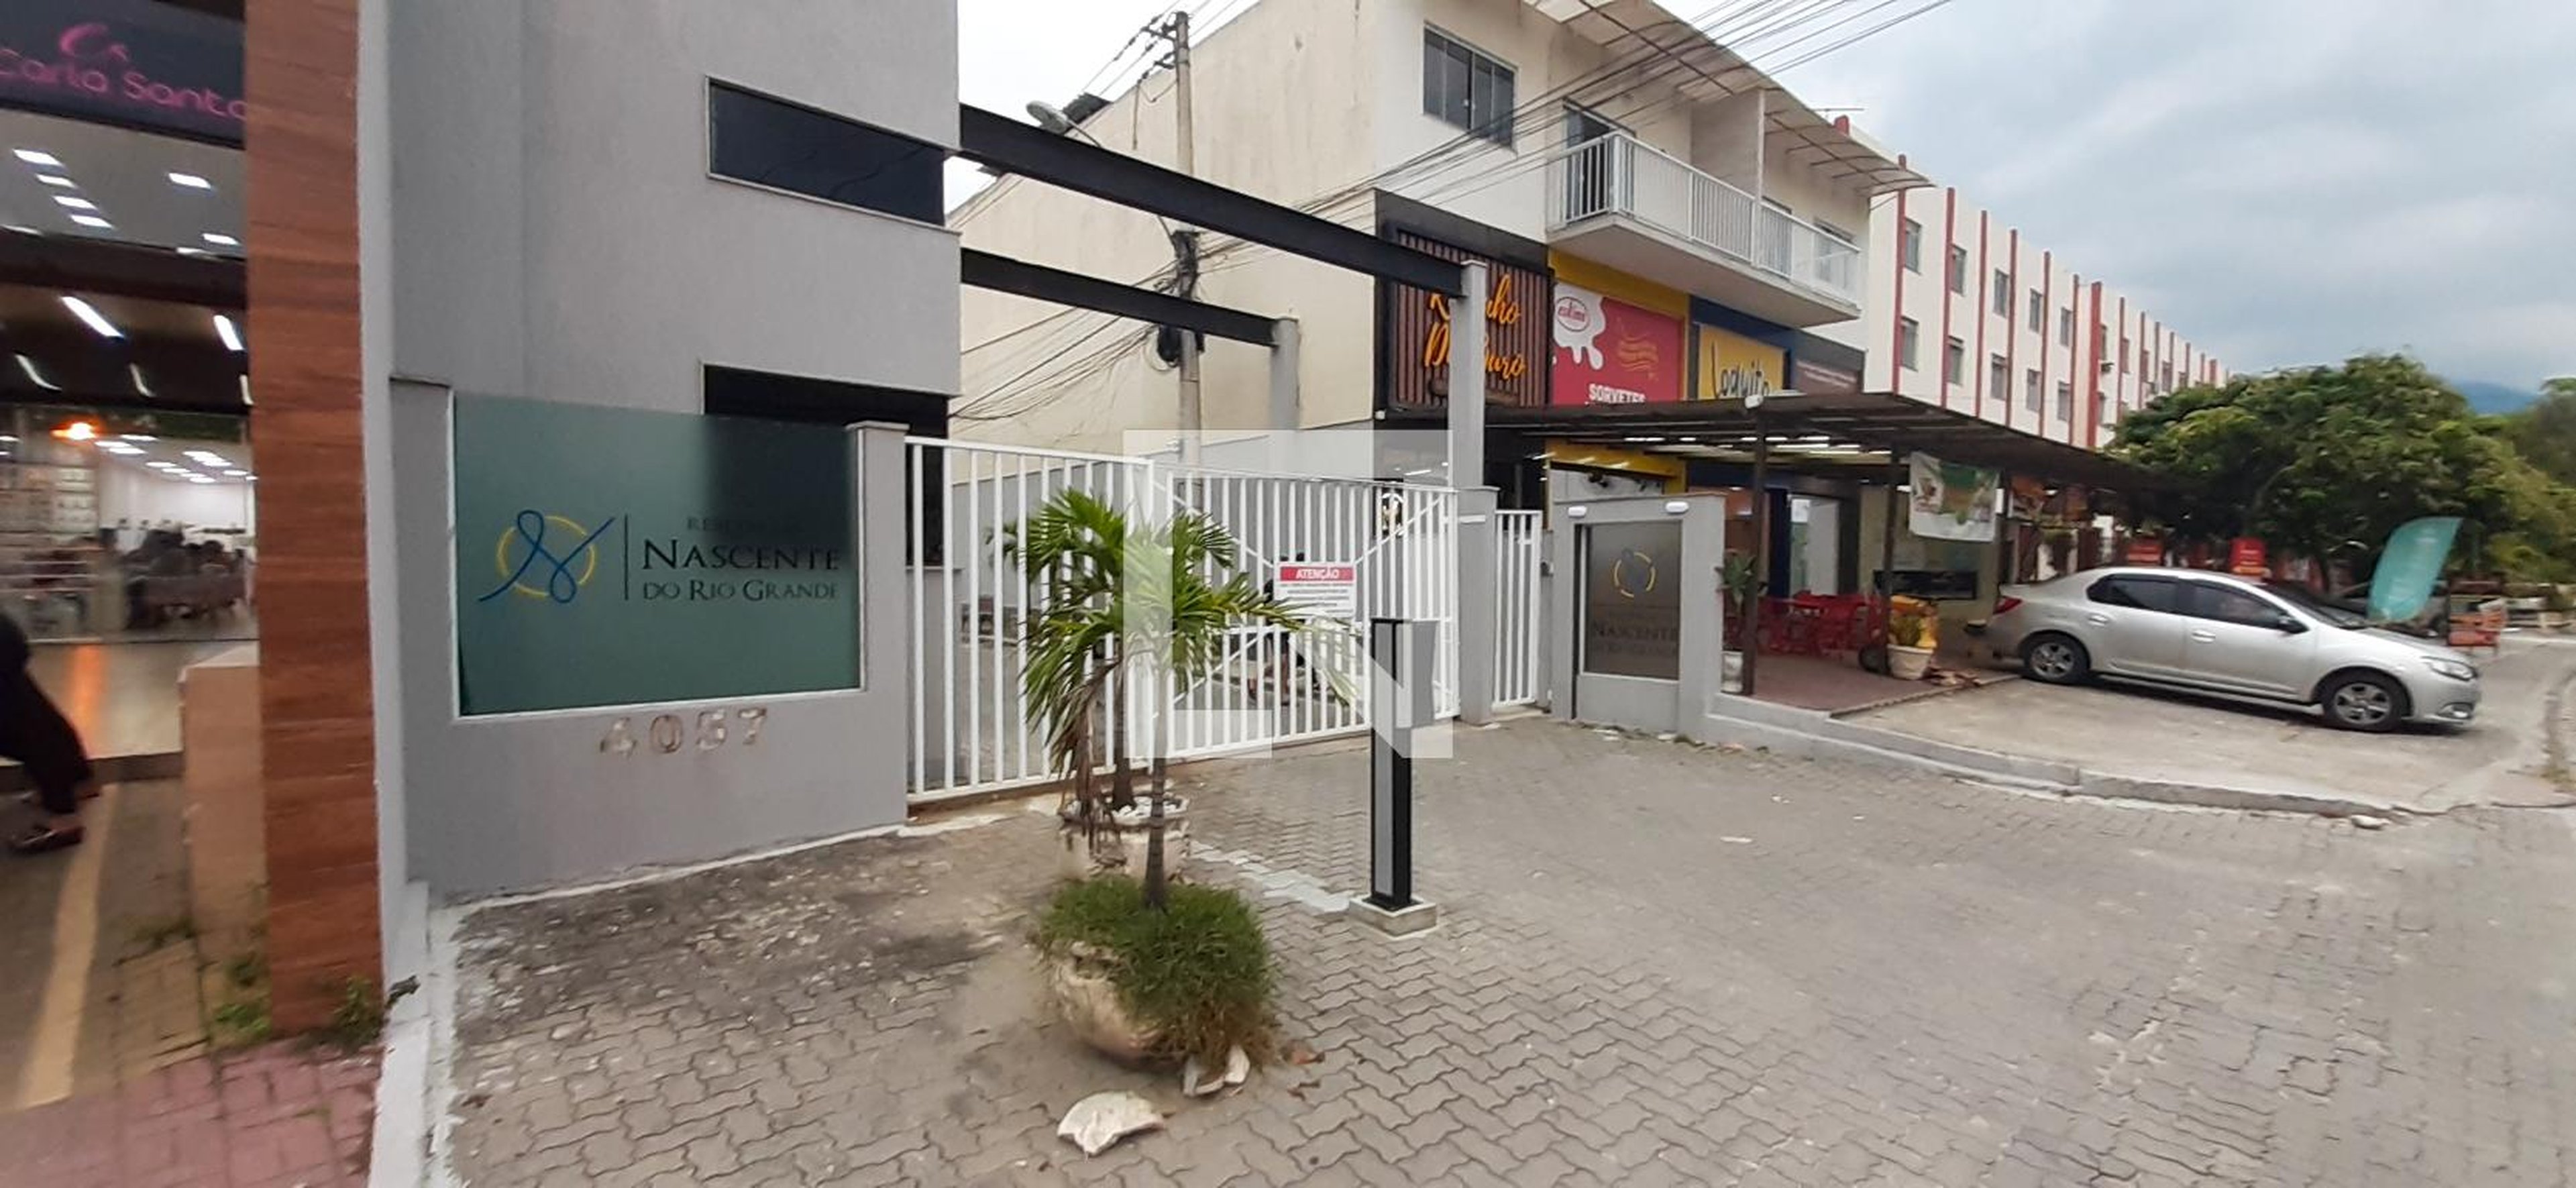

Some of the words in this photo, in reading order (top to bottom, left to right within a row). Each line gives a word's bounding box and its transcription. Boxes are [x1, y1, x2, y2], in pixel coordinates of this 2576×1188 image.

[1295, 566, 1340, 581] ATENÇÃO
[690, 580, 736, 601] RIO
[743, 580, 837, 601] GRANDE
